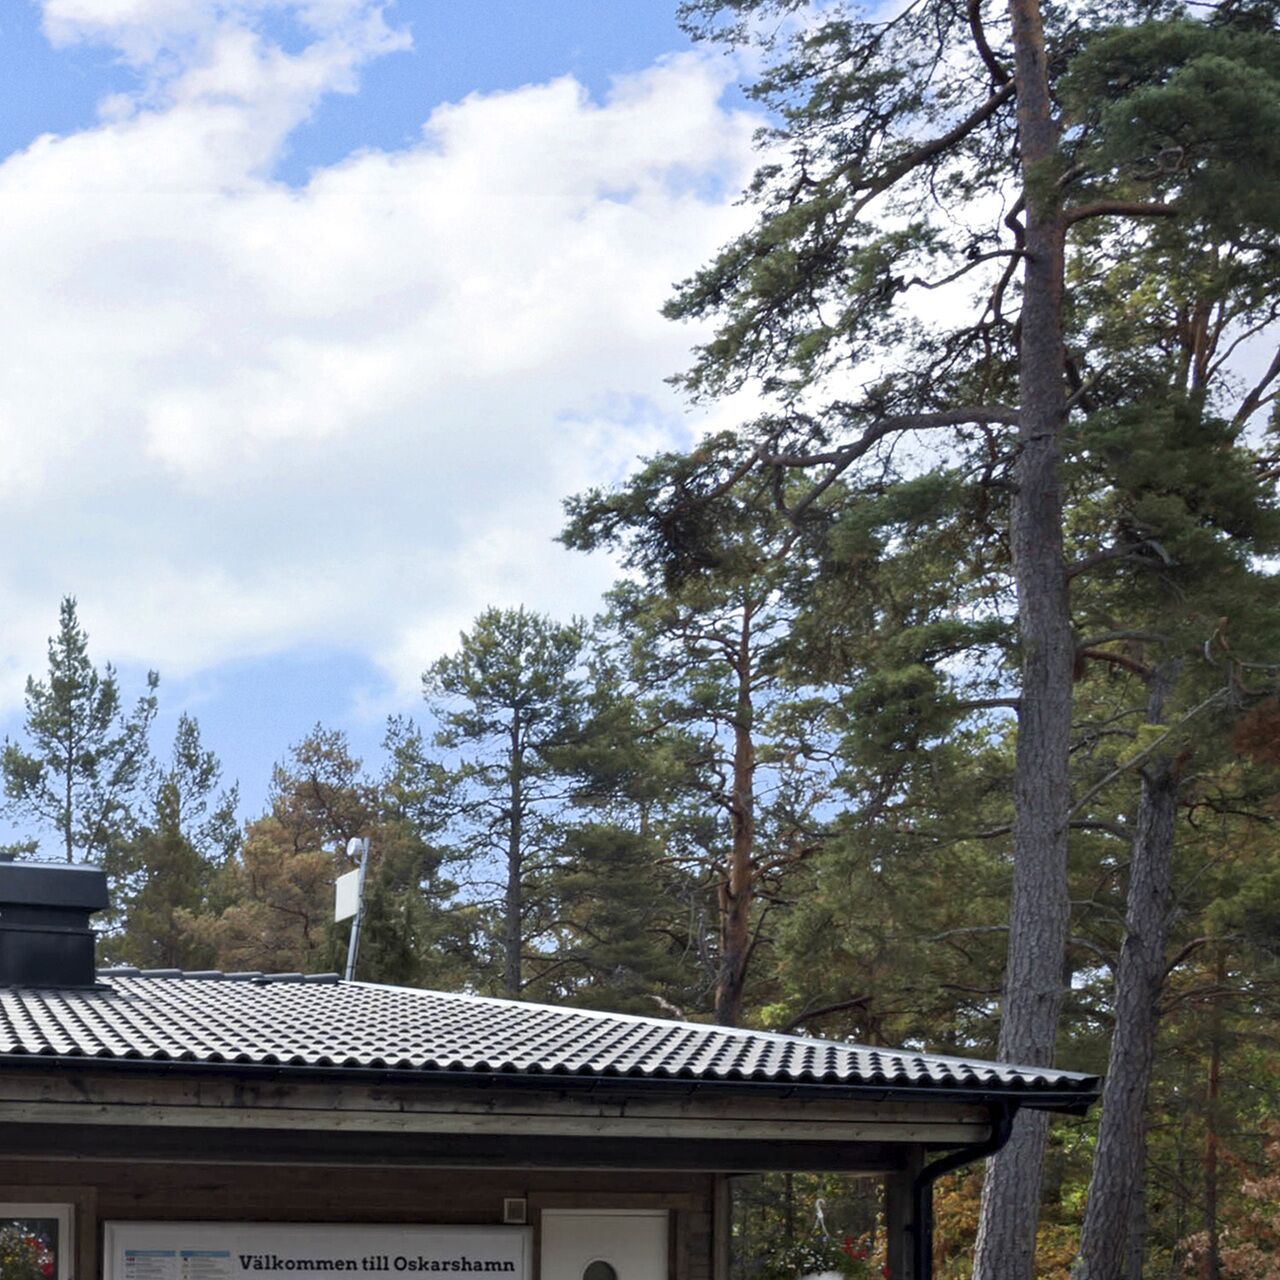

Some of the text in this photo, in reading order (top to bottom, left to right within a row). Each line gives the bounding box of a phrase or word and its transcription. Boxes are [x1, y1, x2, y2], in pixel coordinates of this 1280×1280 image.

[239, 1254, 358, 1271] Välkommen
[361, 1256, 389, 1271] till
[393, 1255, 516, 1272] Oskarshamn
